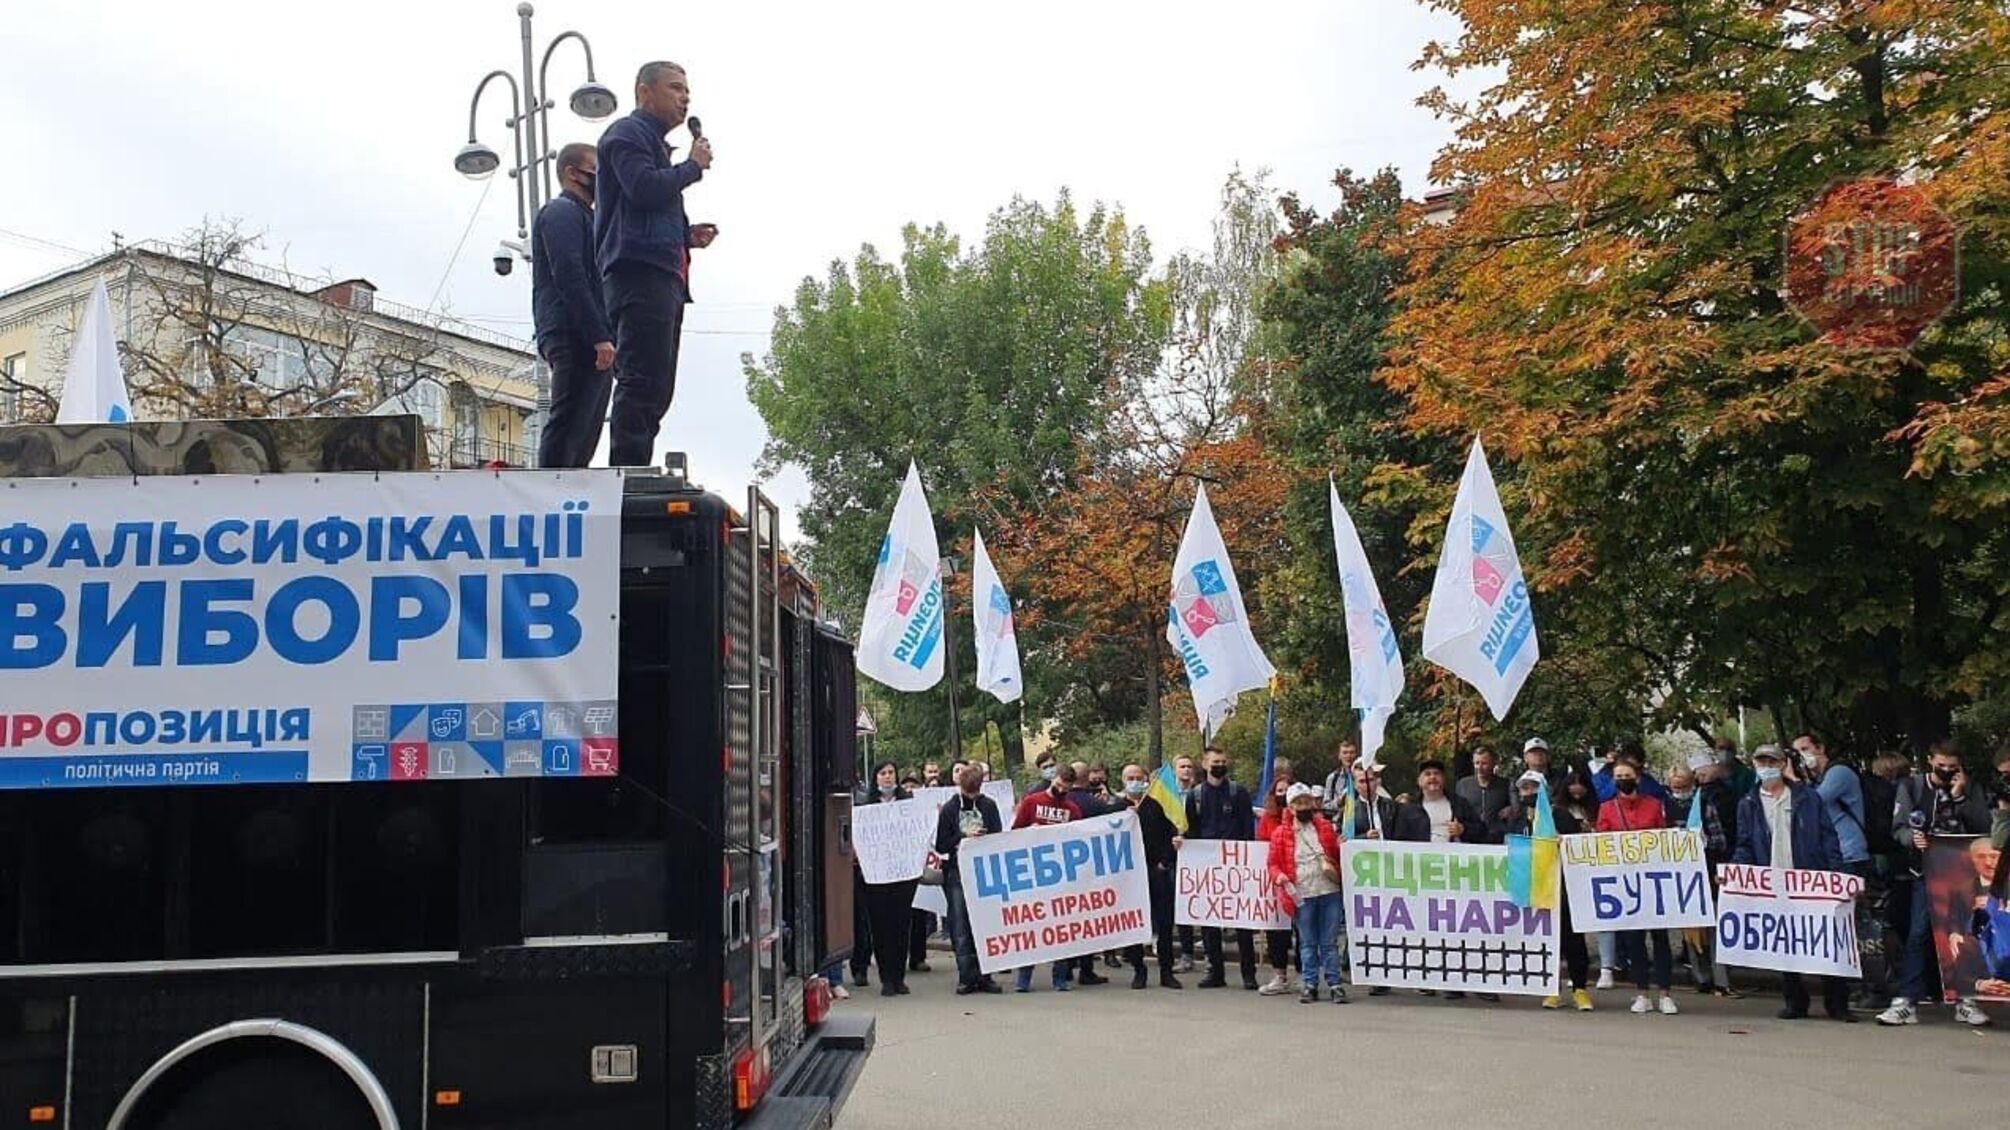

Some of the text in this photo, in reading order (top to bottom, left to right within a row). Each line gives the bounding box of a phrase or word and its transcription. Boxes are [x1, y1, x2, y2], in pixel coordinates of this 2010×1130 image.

[0, 500, 589, 571] ФАЛЬСИФІКАЦІЇ
[0, 573, 583, 668] ВИБОРІВ
[0, 708, 310, 748] РОПОЗИЦІЯ
[65, 757, 220, 780] політична партія
[973, 818, 1134, 901] ЦЕБРІЙ
[1222, 842, 1248, 866] НІ
[1352, 851, 1511, 896] ЯЦЕНК
[1180, 867, 1277, 898] ВИБОРЧИ
[1591, 871, 1707, 919] БУТИ
[1723, 866, 1860, 896] МАЄ ПРАВО
[1002, 888, 1117, 926] МАЄ ПРАВО
[1188, 895, 1279, 922] СХЕМАМ
[1354, 894, 1552, 936] НА НАРИ
[986, 908, 1145, 956] БУТИ ОБРАНИМ!
